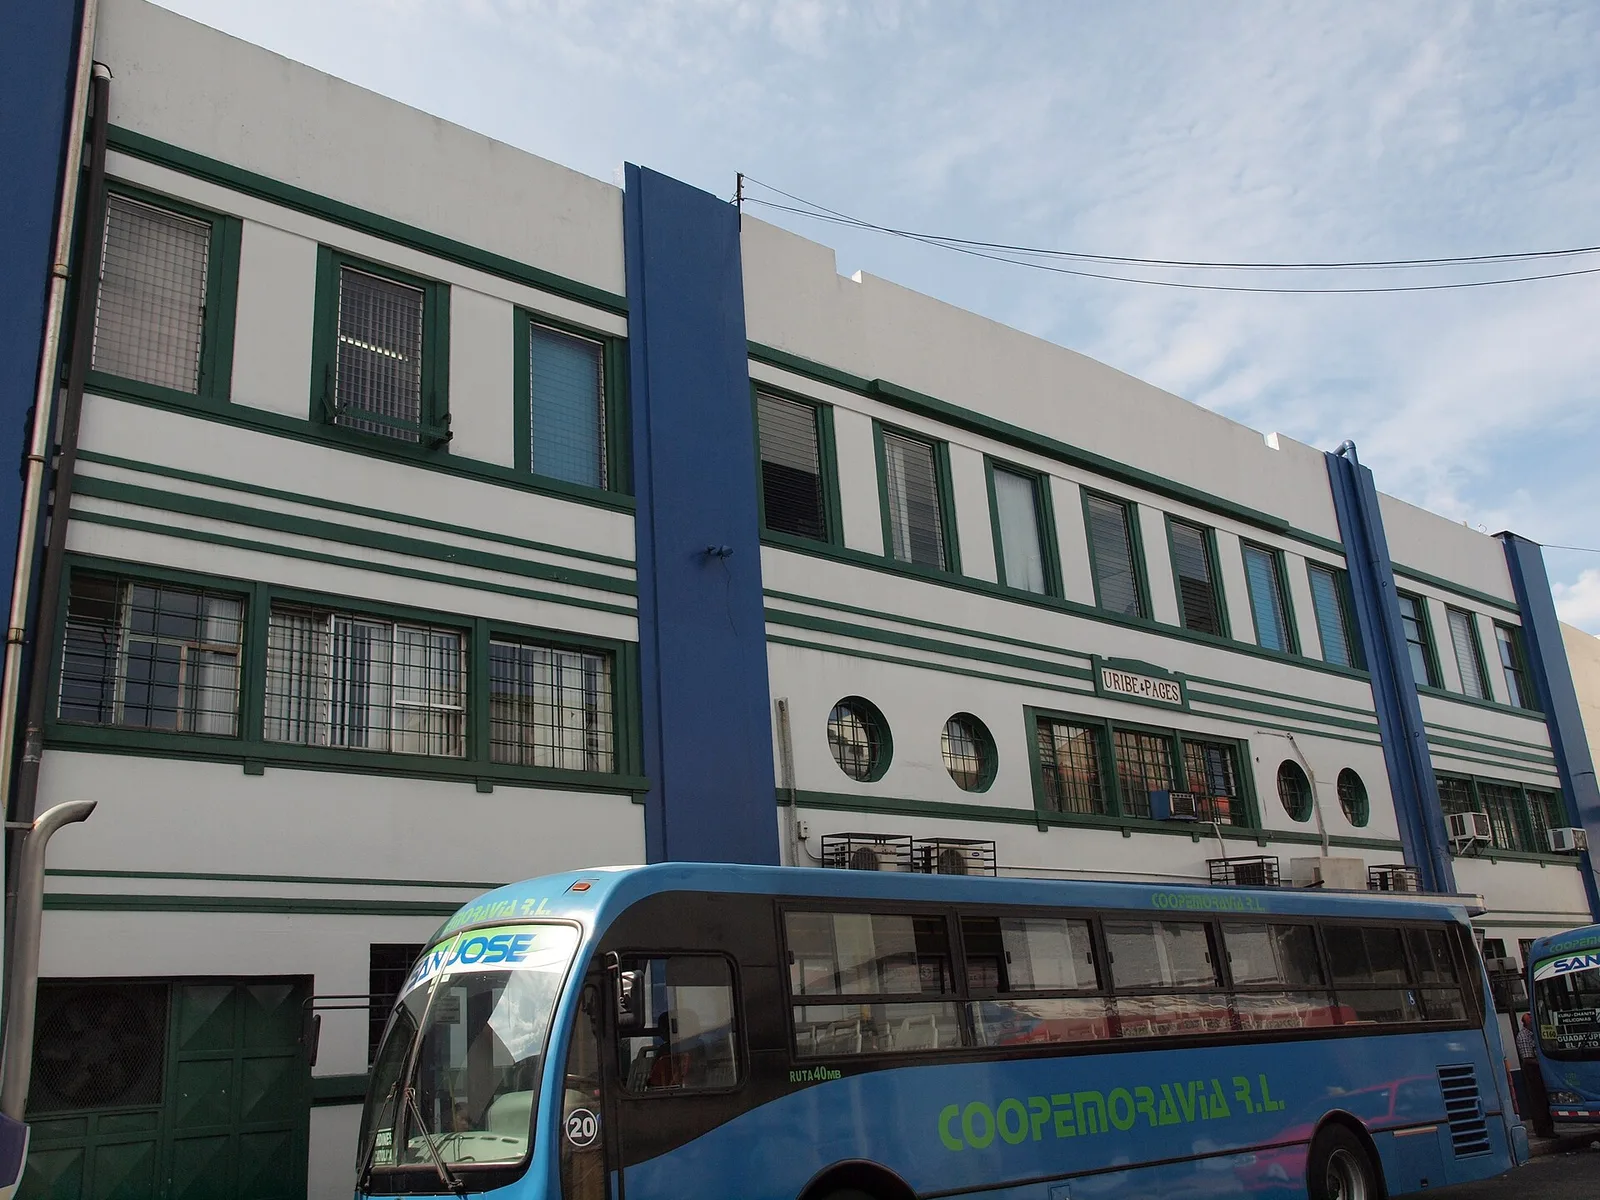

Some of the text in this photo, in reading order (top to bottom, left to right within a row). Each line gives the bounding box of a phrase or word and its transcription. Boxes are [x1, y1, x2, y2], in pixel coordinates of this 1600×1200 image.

[1103, 671, 1139, 694] URIBE
[1144, 679, 1179, 701] PAGES
[447, 933, 537, 966] JOSE
[789, 1070, 814, 1083] RUTA
[1233, 1073, 1286, 1115] R.L.
[570, 1117, 595, 1138] 20
